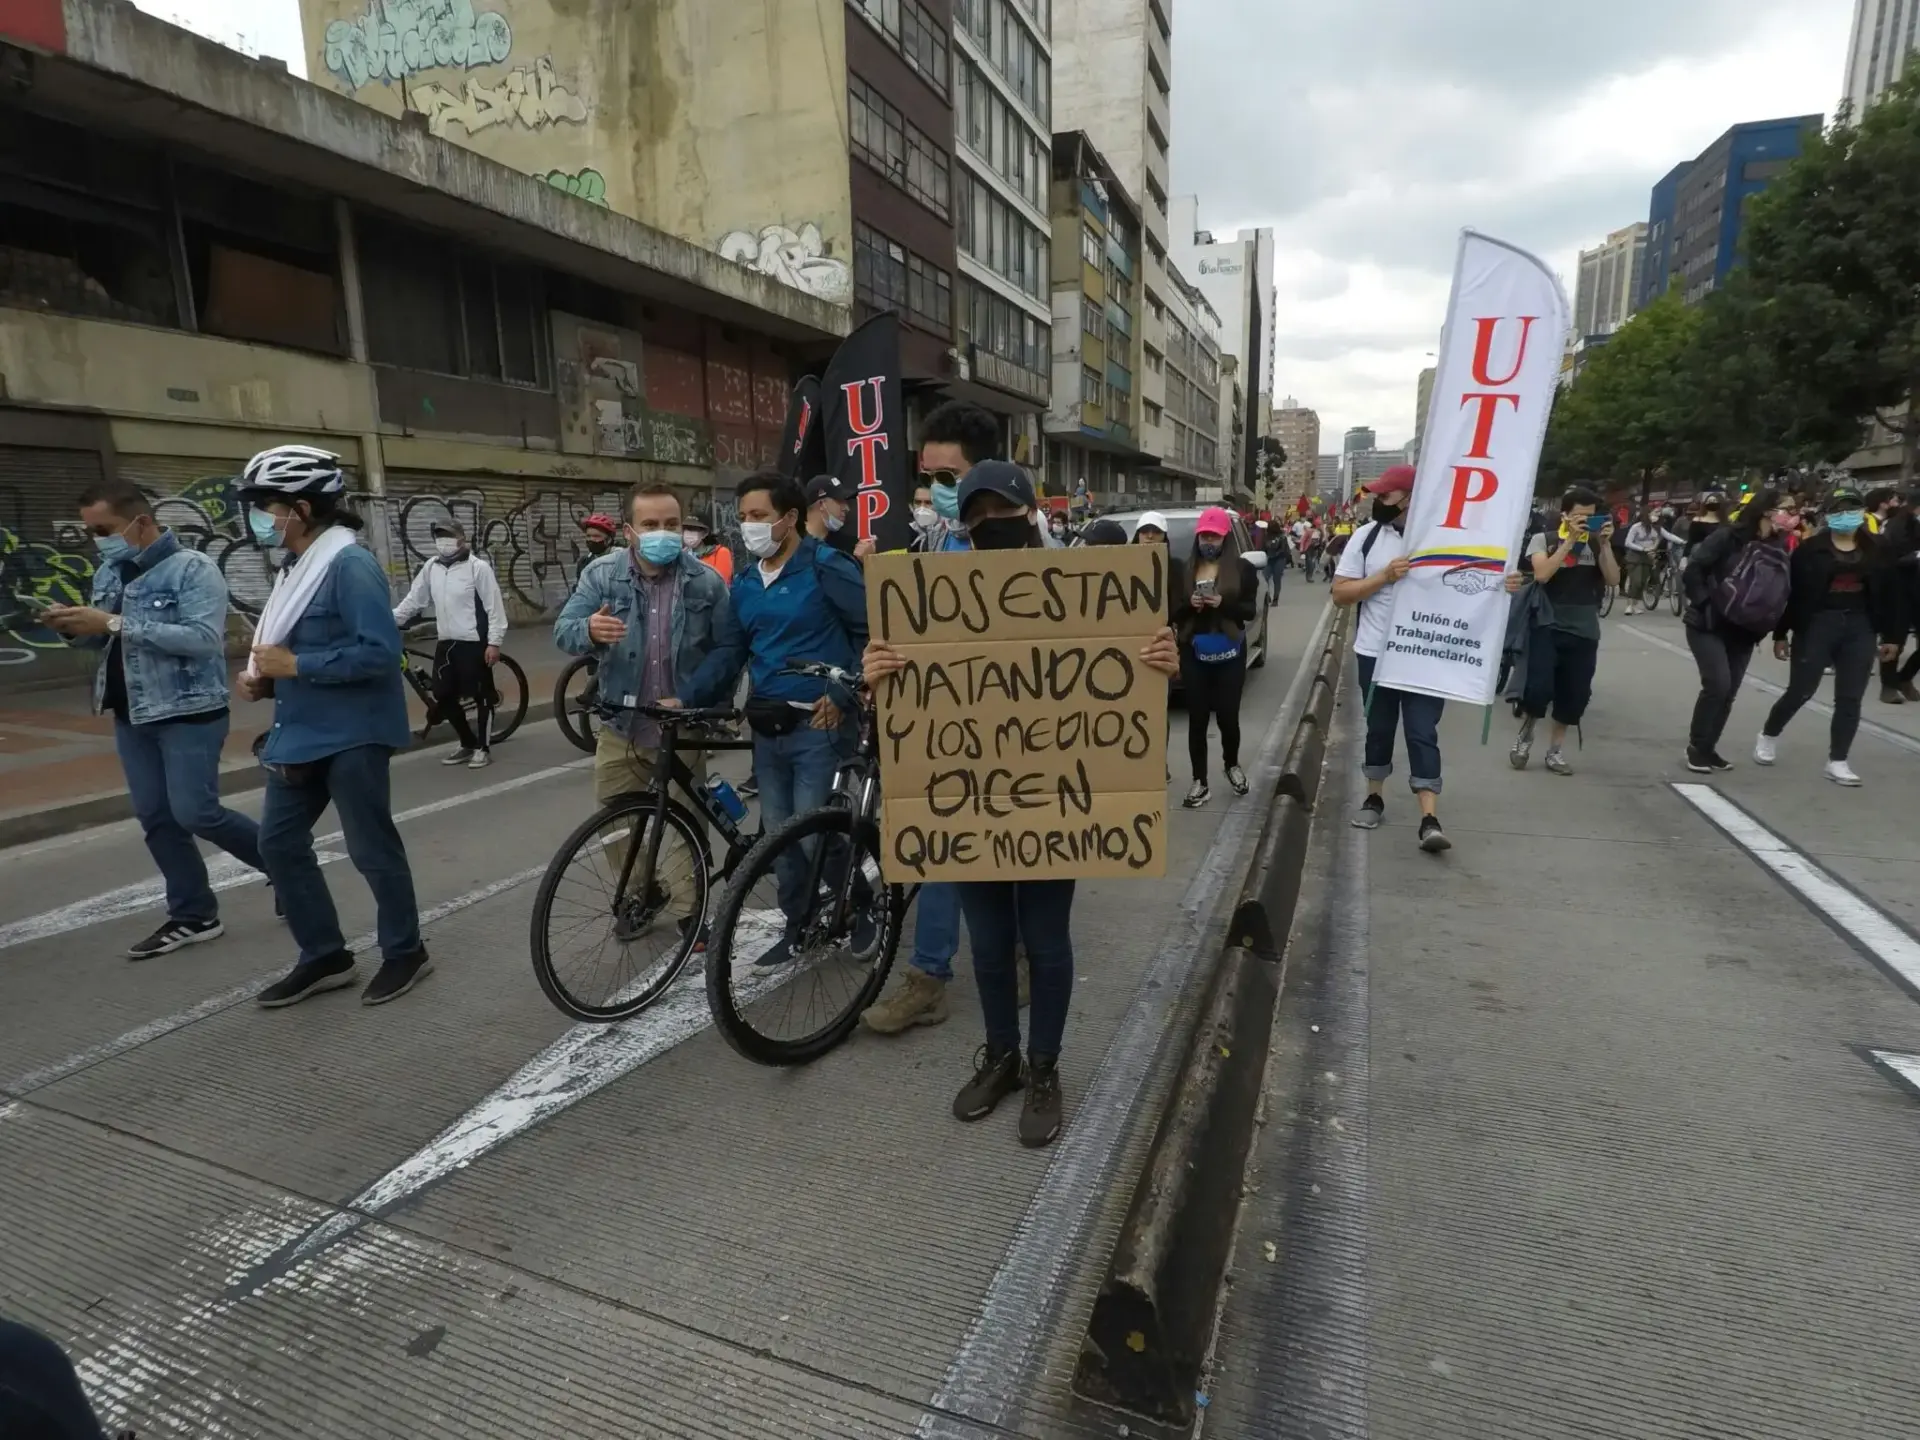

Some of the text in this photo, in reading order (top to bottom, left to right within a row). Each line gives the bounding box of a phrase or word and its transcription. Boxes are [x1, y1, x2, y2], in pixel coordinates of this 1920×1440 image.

[1436, 316, 1541, 530] UTP
[840, 375, 890, 542] UTP
[880, 551, 1163, 641] NOS ESTAN
[1411, 610, 1469, 631] Unión de
[1200, 648, 1238, 662] adidas
[1386, 640, 1483, 668] Penitenciarios
[1394, 625, 1482, 649] Trabajadores
[885, 646, 1135, 710] MATANDO
[885, 710, 1151, 764] Y LOS MEDIOS
[924, 758, 1093, 818] DICEN
[895, 825, 981, 878] QUE
